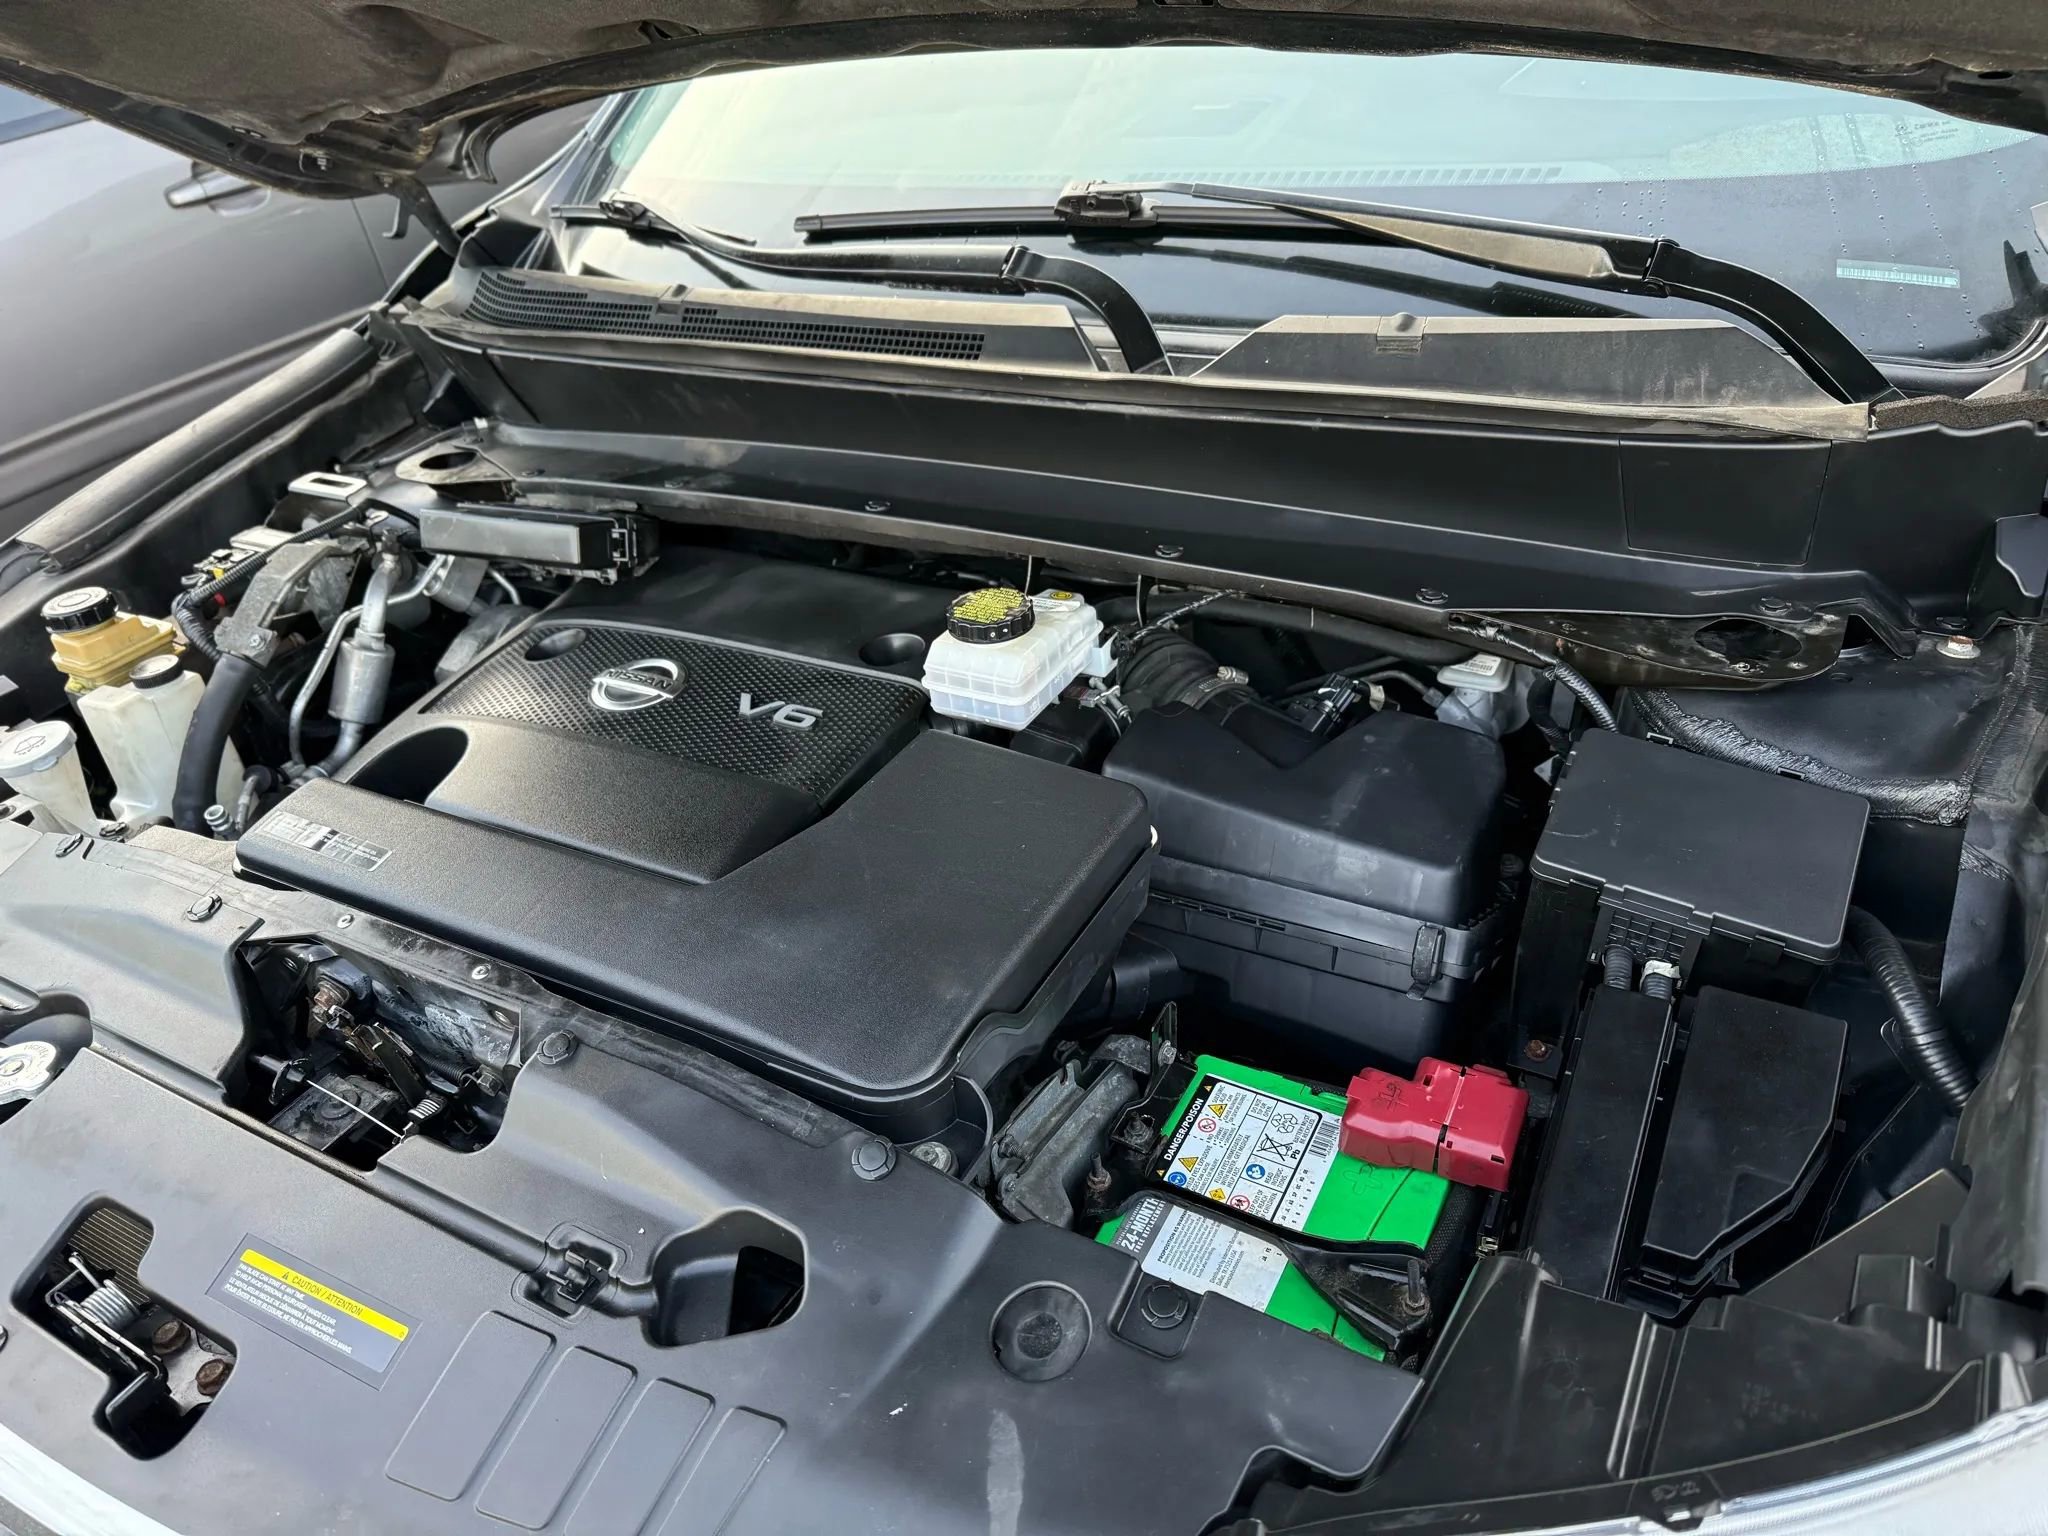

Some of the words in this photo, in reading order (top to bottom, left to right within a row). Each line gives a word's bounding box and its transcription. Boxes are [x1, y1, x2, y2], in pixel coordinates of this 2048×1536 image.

[605, 668, 673, 691] NISSAN
[739, 692, 823, 730] V6
[1163, 1097, 1204, 1161] DANGER/POISON
[1289, 1148, 1301, 1159] Pb
[1121, 1198, 1160, 1250] 24-MONTH
[1134, 1238, 1146, 1253] FREE
[1156, 1232, 1175, 1262] PROPOSITION
[292, 1275, 320, 1297] CAUTION
[325, 1292, 363, 1316] ATTENTION
